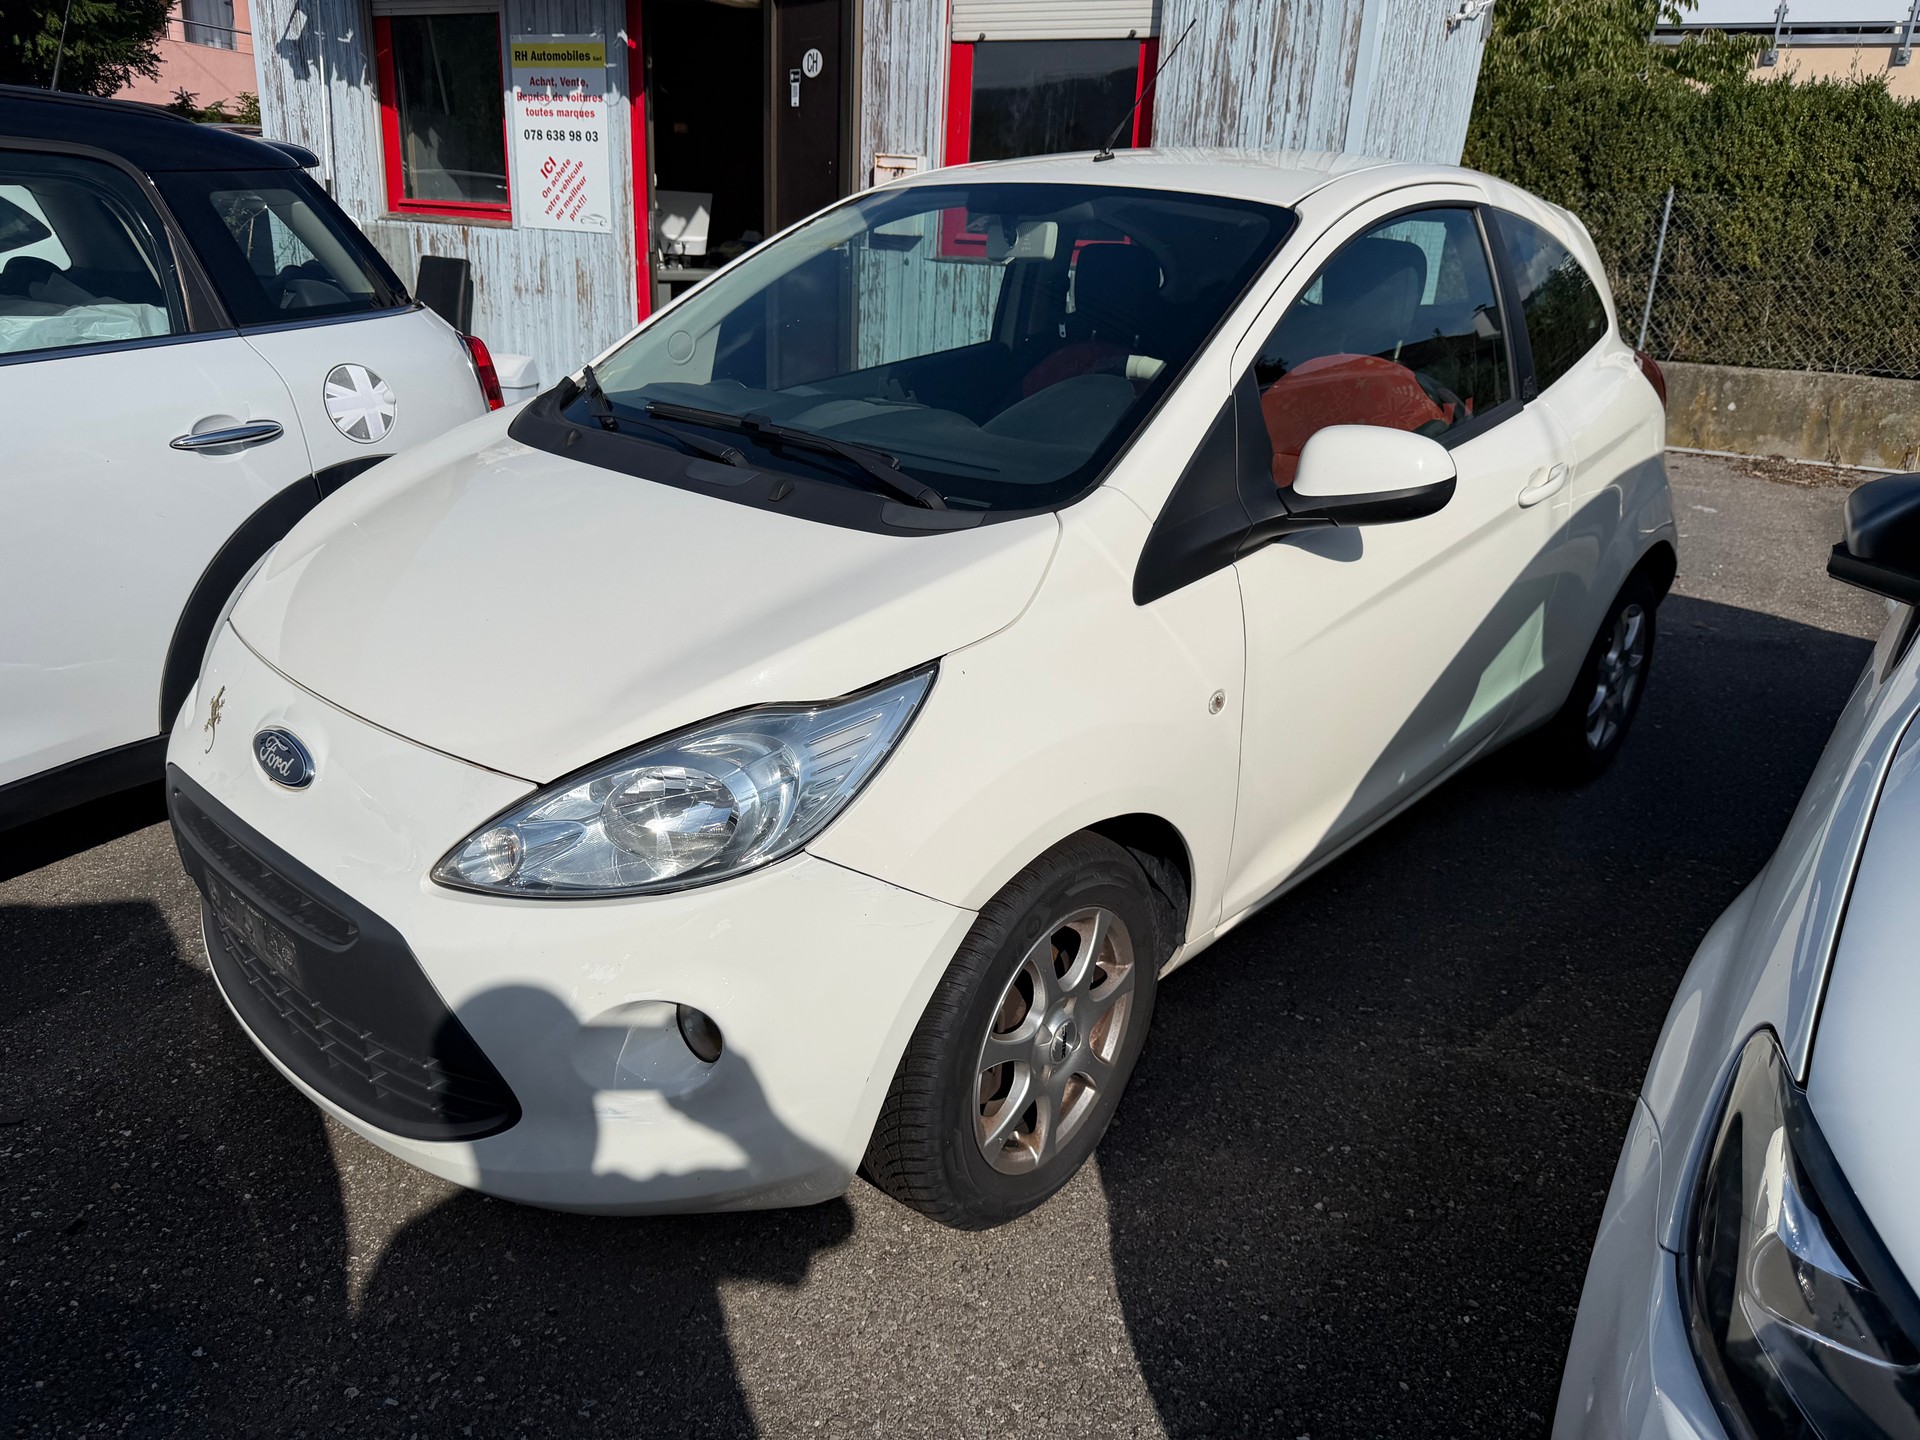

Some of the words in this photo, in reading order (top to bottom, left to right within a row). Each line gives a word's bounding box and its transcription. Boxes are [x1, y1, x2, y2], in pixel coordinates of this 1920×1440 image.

[514, 50, 528, 61] RH
[530, 50, 591, 61] Automobiles
[807, 52, 818, 73] CH
[529, 76, 558, 88] Achat,
[559, 76, 589, 89] Vente,
[516, 91, 551, 103] Reprise
[552, 92, 564, 102] de
[566, 93, 604, 103] voitures
[525, 107, 554, 117] toutes
[556, 108, 596, 120] marques
[523, 129, 543, 141] 078
[546, 129, 566, 141] 638
[568, 130, 582, 142] 98
[585, 131, 599, 142] 03
[540, 155, 557, 180] ICI
[542, 187, 552, 198] On
[545, 194, 560, 215] votre
[559, 161, 583, 194] véhicule
[556, 208, 564, 220] au
[563, 176, 587, 209] meilleur
[569, 194, 587, 221] prix!!!
[260, 735, 295, 777] Ford
